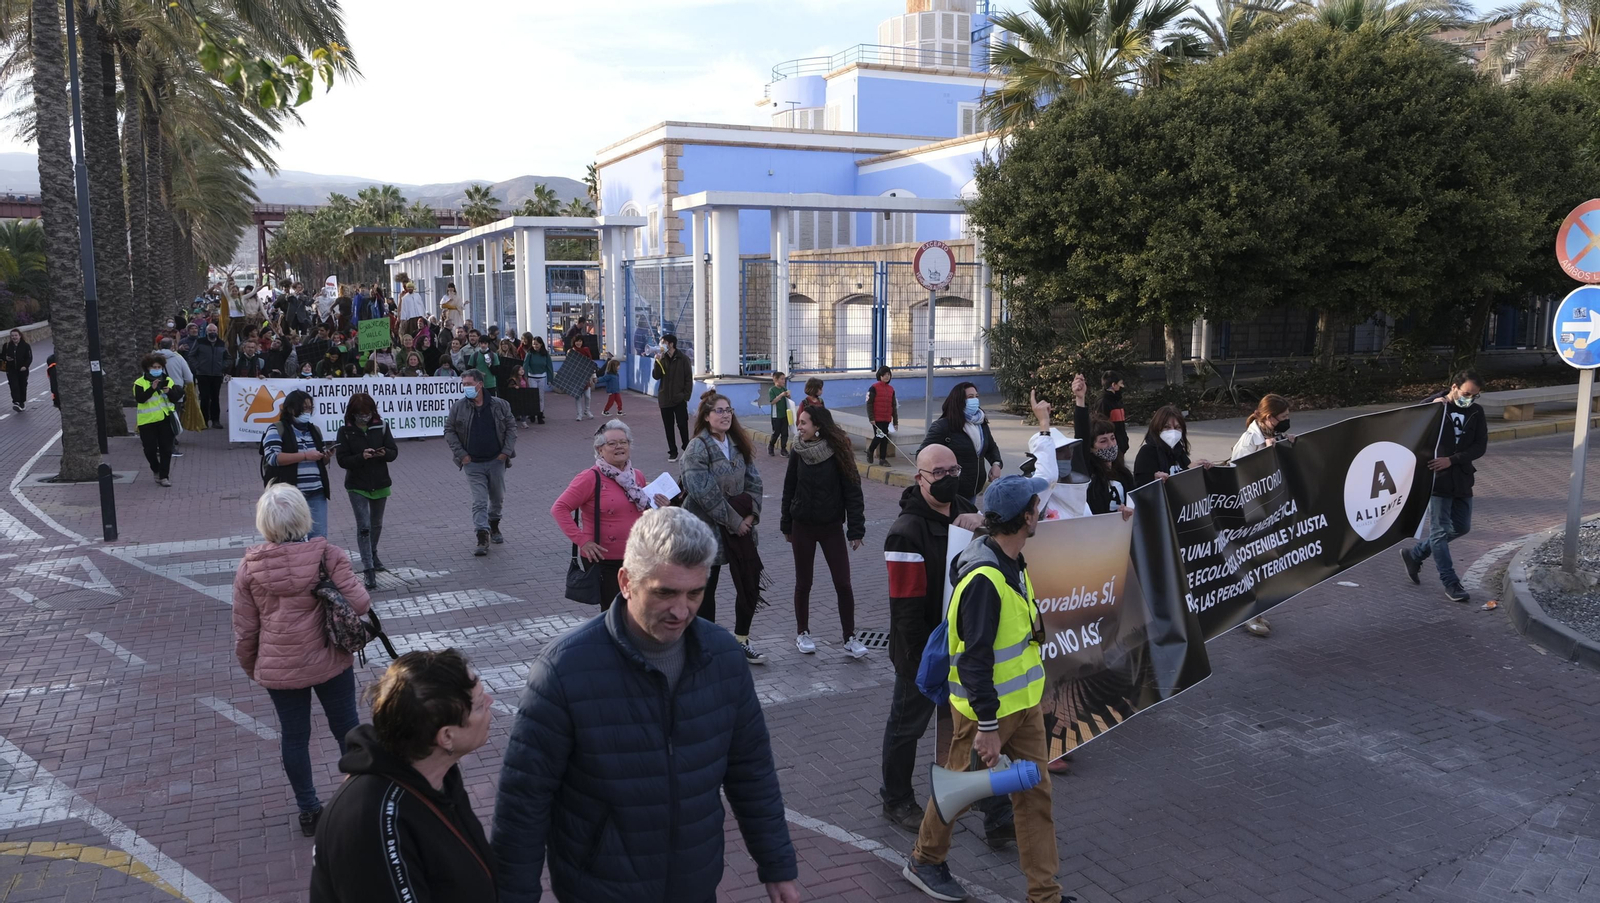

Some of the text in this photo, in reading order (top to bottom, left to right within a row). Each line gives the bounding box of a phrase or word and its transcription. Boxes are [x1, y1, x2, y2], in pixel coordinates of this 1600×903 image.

[921, 241, 949, 252] EXCEPTO
[1560, 259, 1591, 280] AMBOS
[306, 384, 369, 398] PLATAFORMA
[372, 383, 397, 396] PARA
[400, 384, 412, 396] LA
[320, 402, 338, 415] DEL
[382, 400, 394, 413] LA
[397, 397, 413, 412] VÍA
[416, 399, 445, 411] VERDE
[399, 417, 416, 429] LAS
[1370, 460, 1397, 499] A
[1355, 495, 1403, 522] ALIENTE
[1187, 541, 1211, 562] UNA
[1235, 528, 1289, 566] SOSTENIBLE
[1288, 525, 1295, 540] Y
[1296, 513, 1328, 538] JUSTA
[1200, 589, 1216, 612] LAS
[1253, 566, 1261, 583] Y
[1262, 540, 1322, 580] TERRITORIOS
[1100, 575, 1116, 606] SÍ,
[1055, 628, 1080, 656] NO
[387, 839, 400, 865] DKNY
